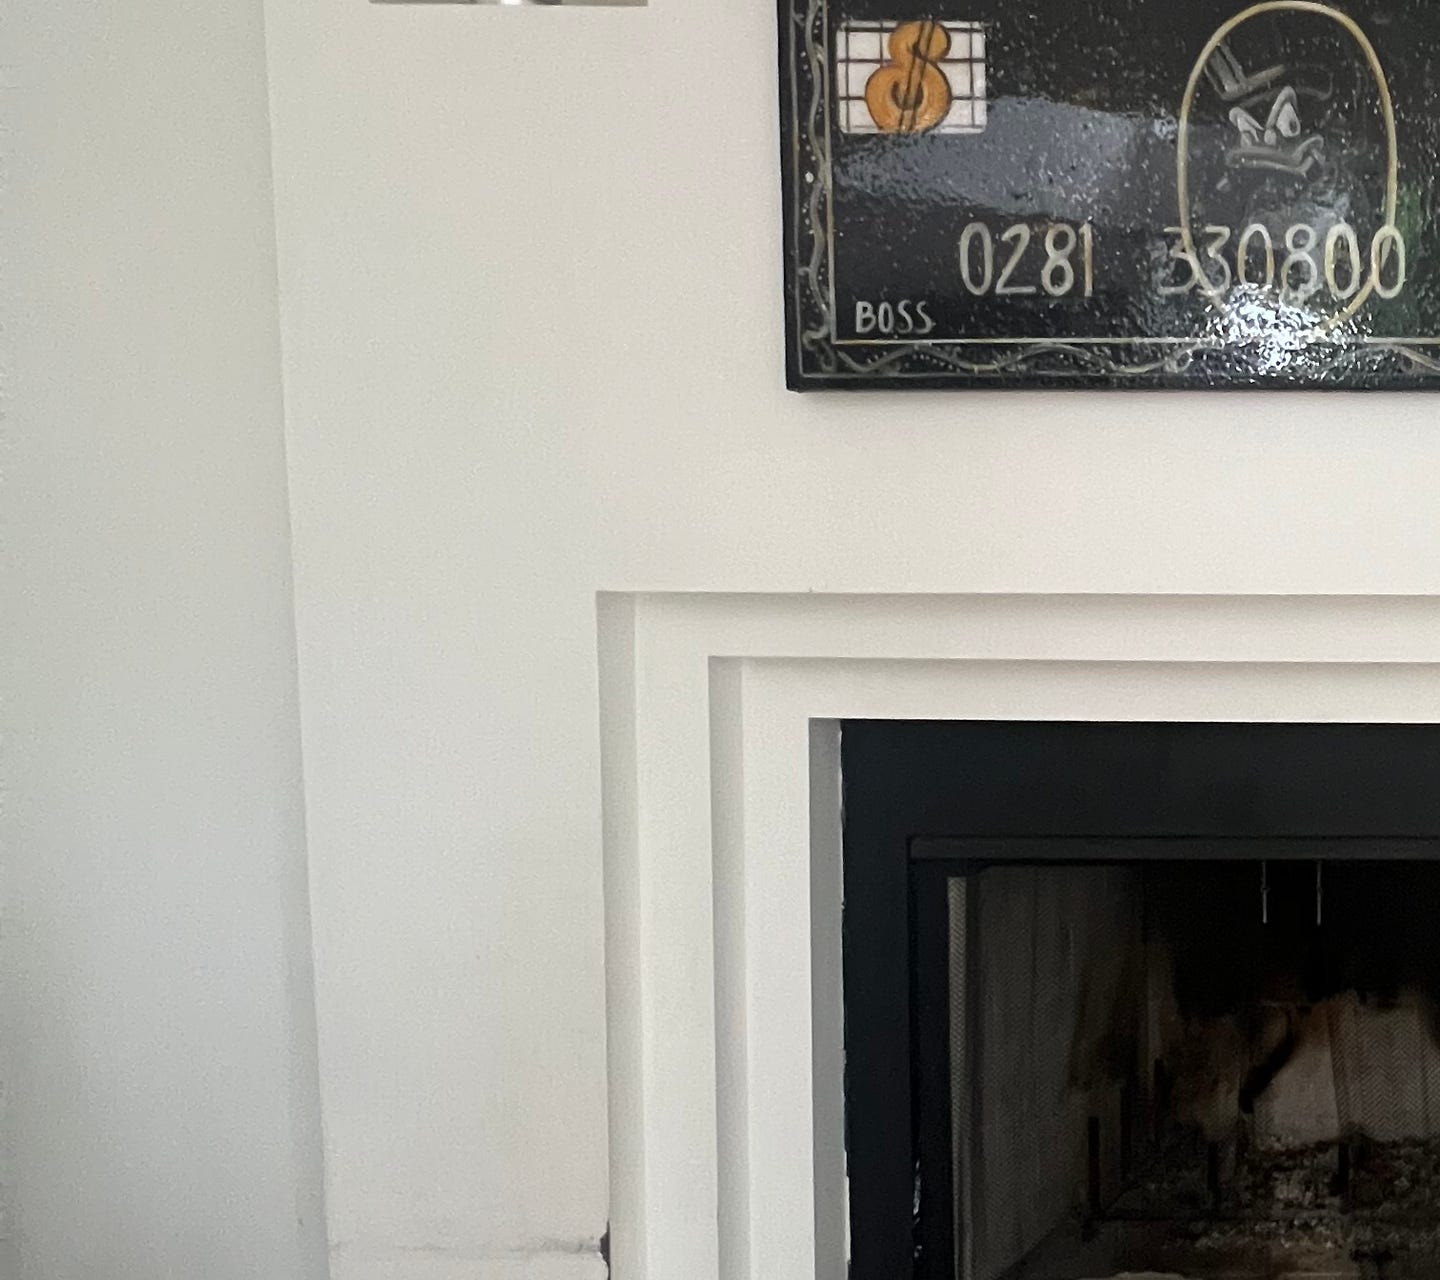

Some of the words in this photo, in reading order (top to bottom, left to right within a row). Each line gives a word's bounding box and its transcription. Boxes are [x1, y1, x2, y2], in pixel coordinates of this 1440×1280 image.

[958, 221, 1093, 298] 0281
[1156, 222, 1406, 302] 330800
[855, 299, 936, 334] BOSS
